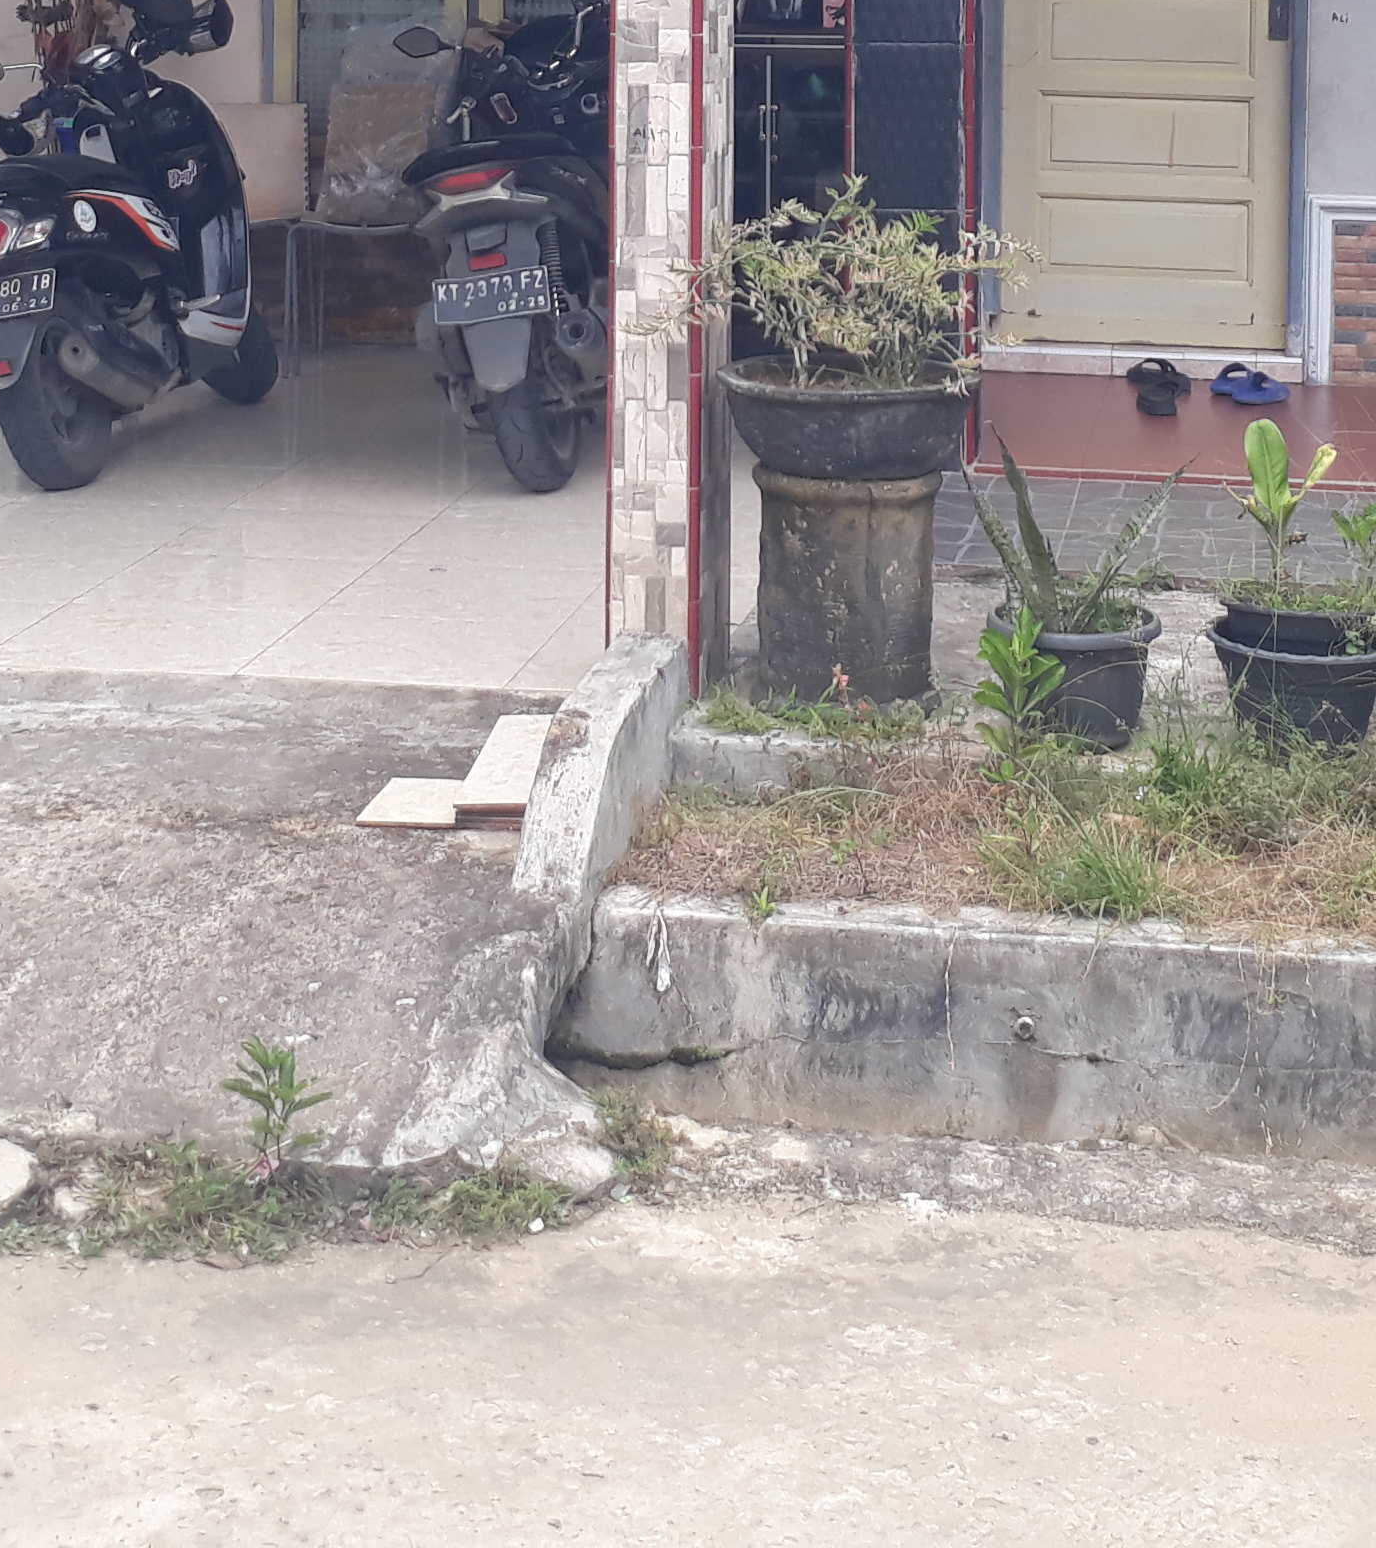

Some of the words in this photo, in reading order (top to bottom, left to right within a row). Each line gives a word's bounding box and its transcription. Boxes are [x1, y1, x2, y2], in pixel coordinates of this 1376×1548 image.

[437, 283, 459, 303] KT
[465, 274, 513, 301] 2373
[520, 269, 544, 290] FZ
